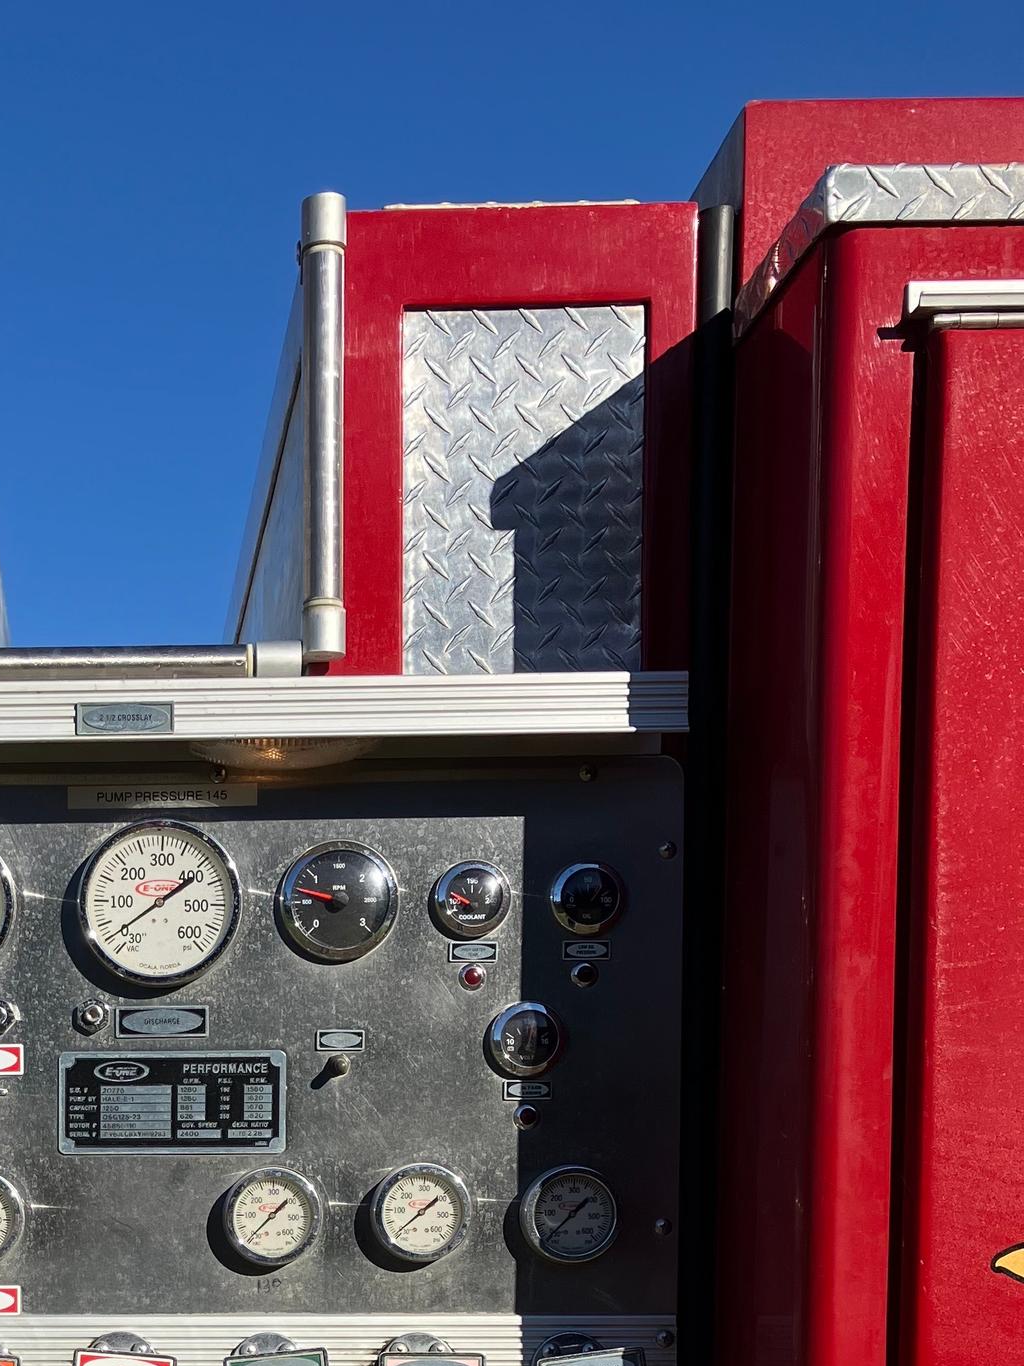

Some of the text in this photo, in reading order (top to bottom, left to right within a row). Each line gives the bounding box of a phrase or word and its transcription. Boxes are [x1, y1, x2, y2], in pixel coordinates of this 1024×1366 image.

[99, 714, 152, 722] 2 1/2 CROSSLAY
[97, 790, 227, 803] PUMP PRESSURE 145
[150, 853, 175, 866] 300
[121, 867, 145, 880] 200
[179, 870, 204, 883] 400
[314, 875, 318, 883] 1
[359, 874, 365, 882] 2
[111, 895, 133, 908] 100
[184, 899, 208, 912] 500
[359, 918, 366, 926] 3
[120, 924, 129, 936] 0
[178, 926, 201, 939] 600
[128, 933, 146, 943] 30"
[159, 962, 181, 970] FLORIDA
[183, 1063, 268, 1074] PERFORMANCE
